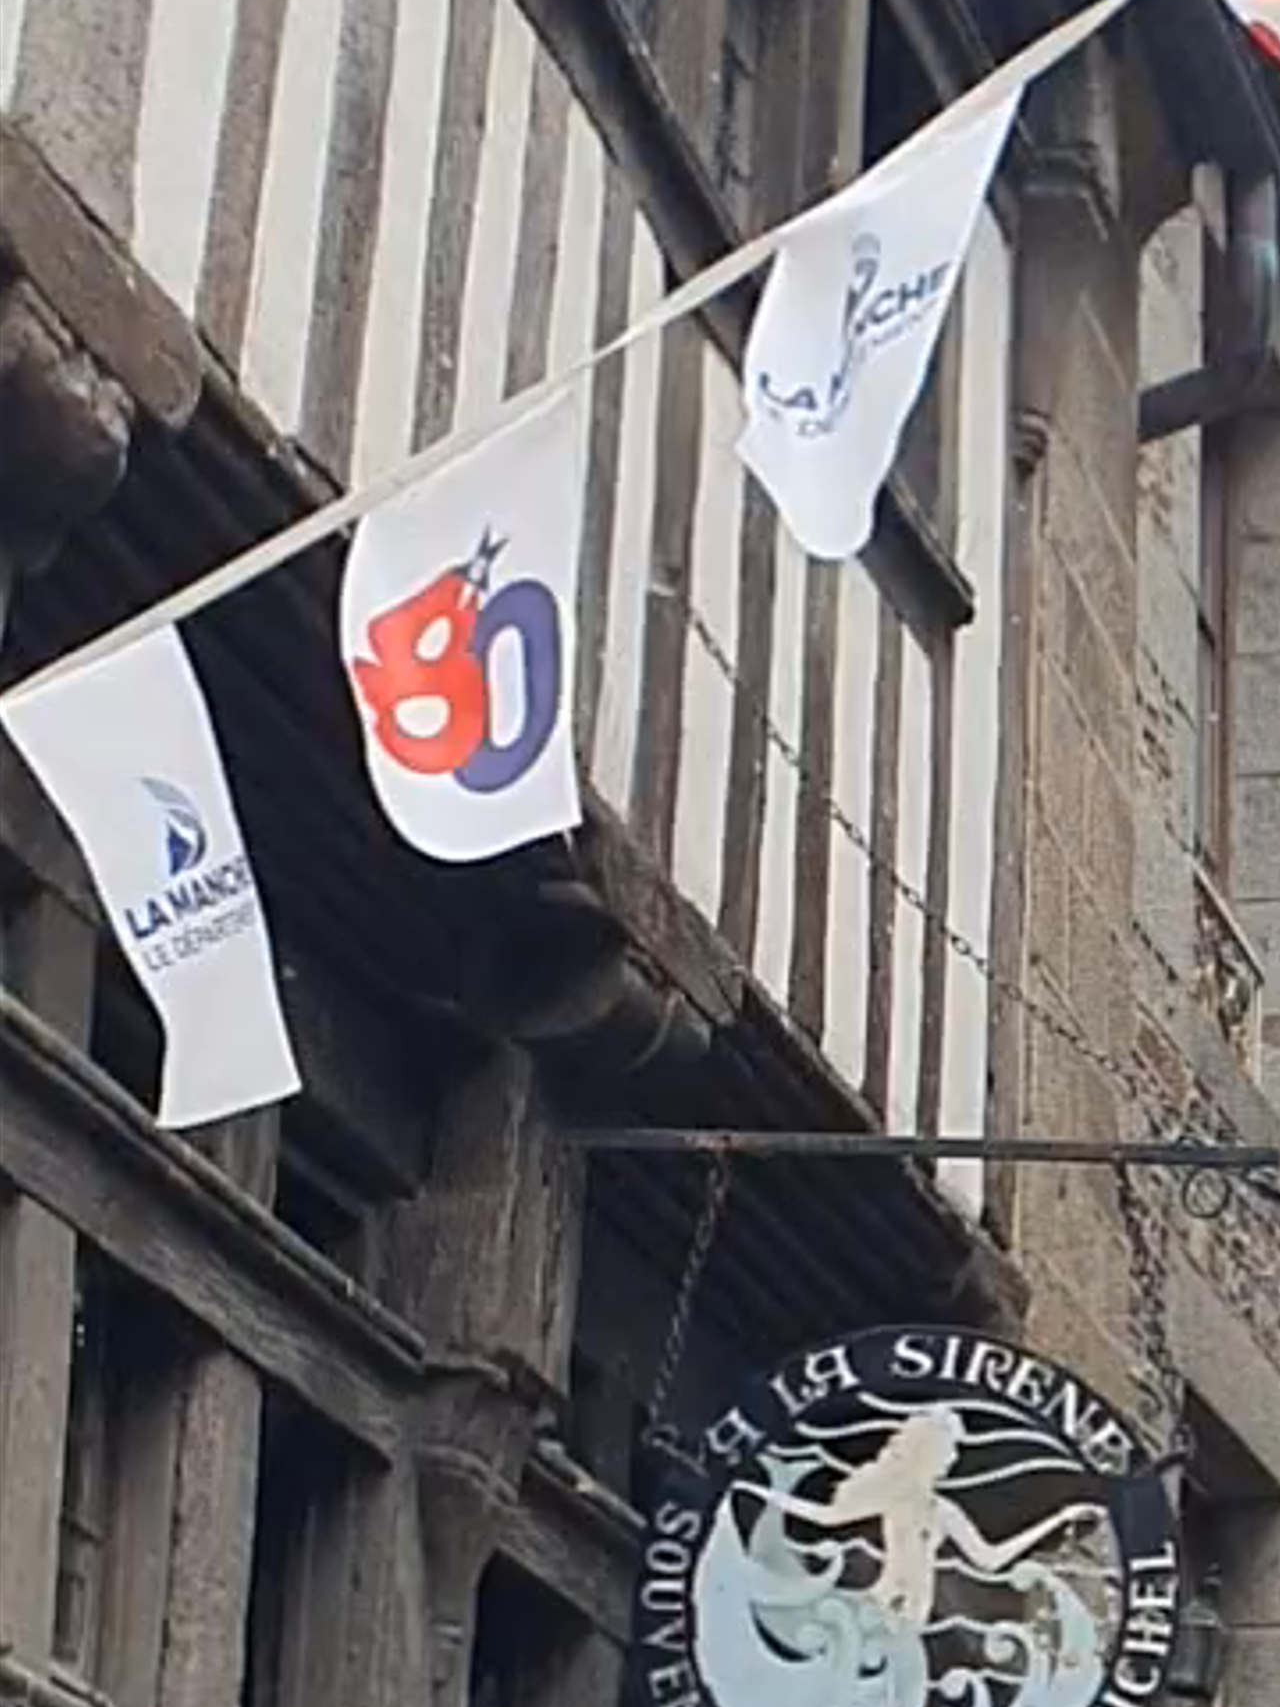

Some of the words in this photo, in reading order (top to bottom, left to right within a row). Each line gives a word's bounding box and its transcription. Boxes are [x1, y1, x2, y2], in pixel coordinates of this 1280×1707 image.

[354, 569, 562, 794] 80
[124, 898, 171, 939] LA
[768, 1345, 862, 1417] LA
[889, 1334, 1134, 1477] SIRENE
